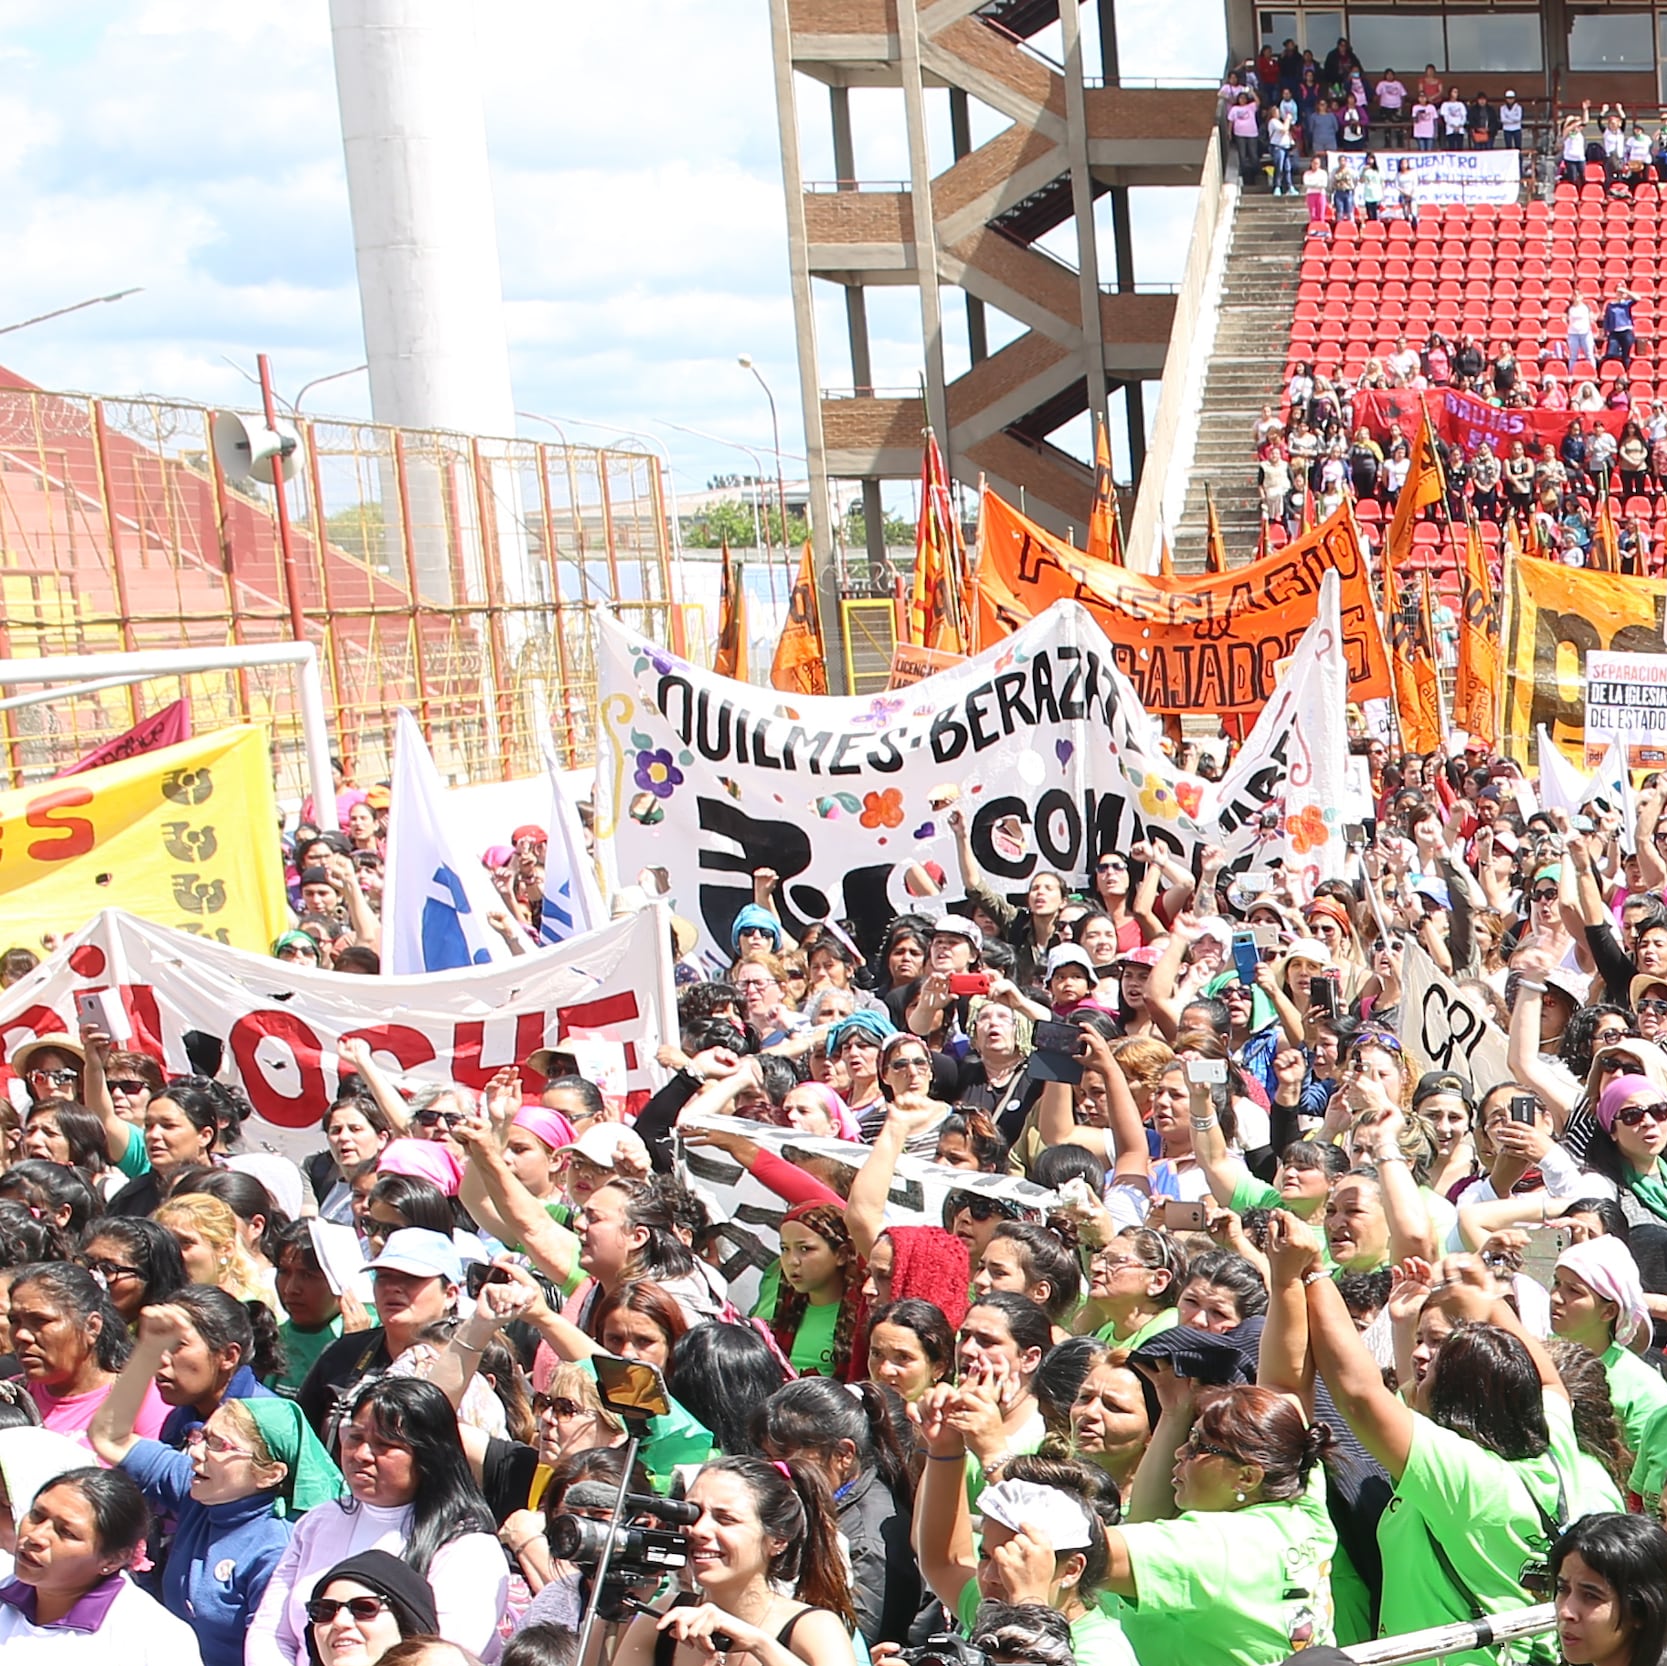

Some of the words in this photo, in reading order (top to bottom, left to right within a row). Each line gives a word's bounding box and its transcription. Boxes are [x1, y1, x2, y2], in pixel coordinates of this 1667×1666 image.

[1444, 392, 1527, 434] BRUJAS
[1591, 682, 1607, 703] DE
[1608, 684, 1624, 705] LA
[1590, 707, 1614, 728] DEL
[1618, 709, 1667, 731] ESTADO
